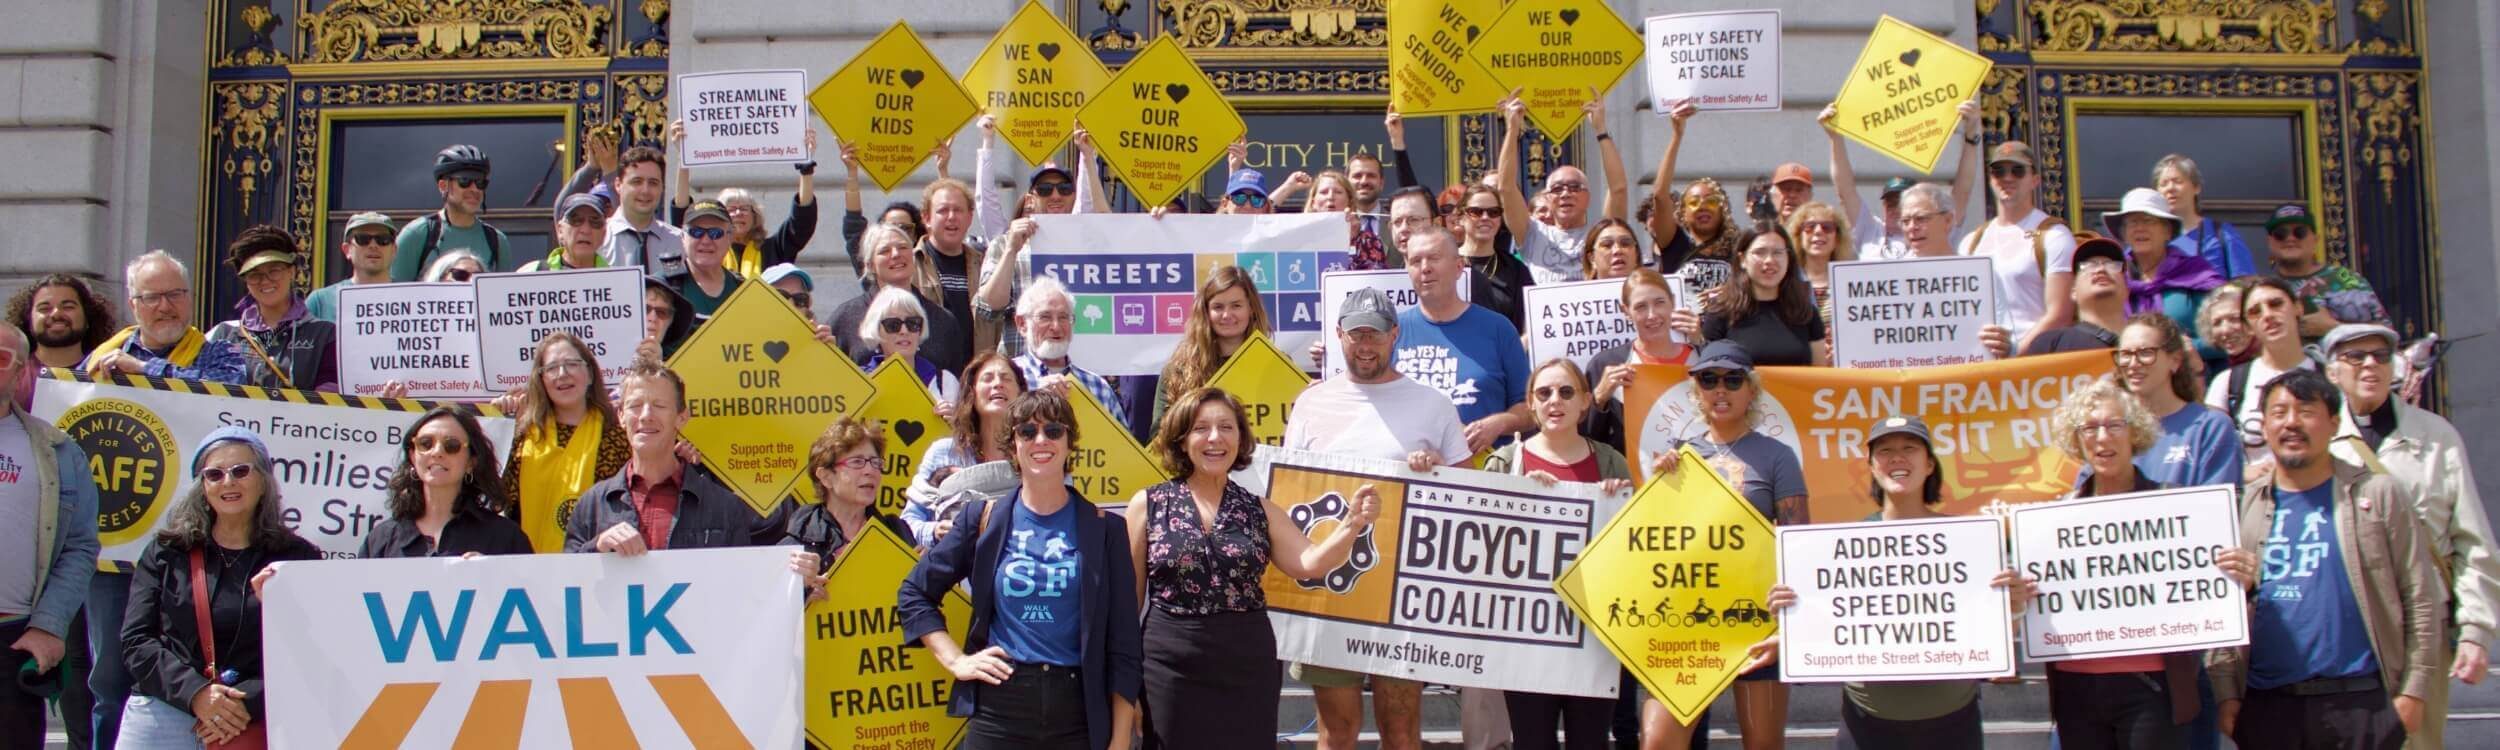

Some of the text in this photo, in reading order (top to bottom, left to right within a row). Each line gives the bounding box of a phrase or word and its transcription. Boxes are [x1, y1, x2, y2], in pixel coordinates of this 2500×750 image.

[1440, 3, 1467, 32] WE
[1528, 11, 1553, 26] WE
[1431, 29, 1464, 64] OUR
[1540, 31, 1573, 46] OUR
[1662, 29, 1763, 47] APPLY SAFETY
[1003, 44, 1030, 61] WE
[1491, 50, 1623, 68] NEIGHBORHOODS
[1671, 47, 1749, 64] SOLUTIONS
[1404, 34, 1465, 95] SENIORS
[1678, 64, 1745, 80] AT SCALE
[1866, 59, 1895, 82] WE
[867, 67, 895, 87] WE
[1017, 68, 1053, 85] SAN
[1886, 73, 1922, 98] SAN
[699, 88, 787, 104] STREAMLINE
[987, 91, 1085, 108] FRANCISCO
[1132, 82, 1160, 101] WE
[1533, 87, 1581, 97] Support the
[1703, 93, 1767, 104] Street Safety Act
[875, 93, 914, 112] OUR
[1531, 99, 1584, 109] Street Safety
[1862, 83, 1959, 131] FRANCISCO
[690, 105, 798, 121] STREET SAFETY
[1142, 108, 1180, 127] OUR
[1551, 110, 1565, 119] Act
[710, 121, 779, 137] PROJECTS
[870, 117, 914, 135] KIDS
[1013, 118, 1058, 129] Support the
[1010, 129, 1061, 140] Street Safety
[1029, 139, 1043, 148] Act
[1119, 131, 1198, 153] SENIORS
[693, 146, 798, 160] Support the Street Safety Act
[866, 142, 914, 154] Support the
[1243, 141, 1315, 168] CITY
[863, 152, 915, 165] Street Safety
[881, 163, 896, 173] Act
[1134, 158, 1180, 171] Support the
[1131, 168, 1183, 183] Street Safety
[1149, 181, 1163, 192] Act
[1044, 262, 1182, 284] STREETS
[1848, 275, 1979, 298] MAKE TRAFFIC
[507, 287, 612, 307] ENFORCE THE
[356, 302, 411, 318] DESIGN
[489, 304, 632, 326] MOST DANGEROUS
[1542, 305, 1554, 319] A
[1847, 299, 1982, 322] SAFETY A CITY
[356, 319, 449, 336] TO PROTECT
[1544, 323, 1556, 339] &
[1874, 324, 1958, 344] PRIORITY
[397, 336, 442, 352] MOST
[721, 344, 754, 362] WE
[1417, 345, 1434, 358] YES
[1436, 346, 1450, 357] for
[370, 354, 470, 370] VULNERABLE
[1395, 358, 1458, 373] OCEAN
[1851, 354, 1984, 368] Support the Street Safety Act
[408, 380, 437, 391] Street
[440, 380, 470, 392] Safety
[739, 370, 781, 389] OUR
[688, 394, 846, 418] EIGHBORHOODS
[1812, 385, 1902, 421] SAN
[217, 412, 260, 435] San
[271, 416, 378, 444] Francisco
[1656, 401, 1685, 436] SAN
[65, 401, 176, 456] FRANCISCO BAY AREA
[98, 439, 119, 447] FOR
[730, 442, 794, 456] Support the
[727, 456, 798, 470] Street Safety
[89, 454, 158, 495] AFE
[754, 472, 773, 484] Act
[1100, 476, 1120, 496] IS
[1414, 489, 1584, 518] SAN FRANCISCO
[2057, 515, 2190, 549] RECOMMIT
[2268, 508, 2292, 543] I
[1012, 529, 1034, 561] I
[1628, 524, 1745, 552] KEEP US
[1833, 532, 1947, 560] ADDRESS
[1406, 515, 1580, 582] BICYCLE
[2027, 557, 2076, 583] SAN
[2263, 541, 2329, 580] SF
[1003, 559, 1077, 597] SF
[1652, 562, 1720, 588] SAFE
[1817, 561, 1968, 590] DANGEROUS
[1832, 591, 1956, 618] SPEEDING
[2036, 577, 2228, 615] TO VISION ZERO
[1023, 604, 1049, 612] WALK
[1400, 584, 1574, 637] COALITION
[362, 582, 697, 663] WALK
[1834, 620, 1957, 646] CITYWIDE
[2043, 619, 2224, 648] Support the Street Safety Act
[1648, 638, 1720, 653] Support the
[857, 644, 914, 676] ARE
[1346, 637, 1485, 674] www.sfbike.org
[1647, 655, 1726, 671] Street Safety
[1804, 649, 1989, 668] Support the Street Safety Act
[1675, 672, 1697, 686] Act
[830, 679, 948, 718] FRAGILE
[855, 720, 930, 742] Support the
